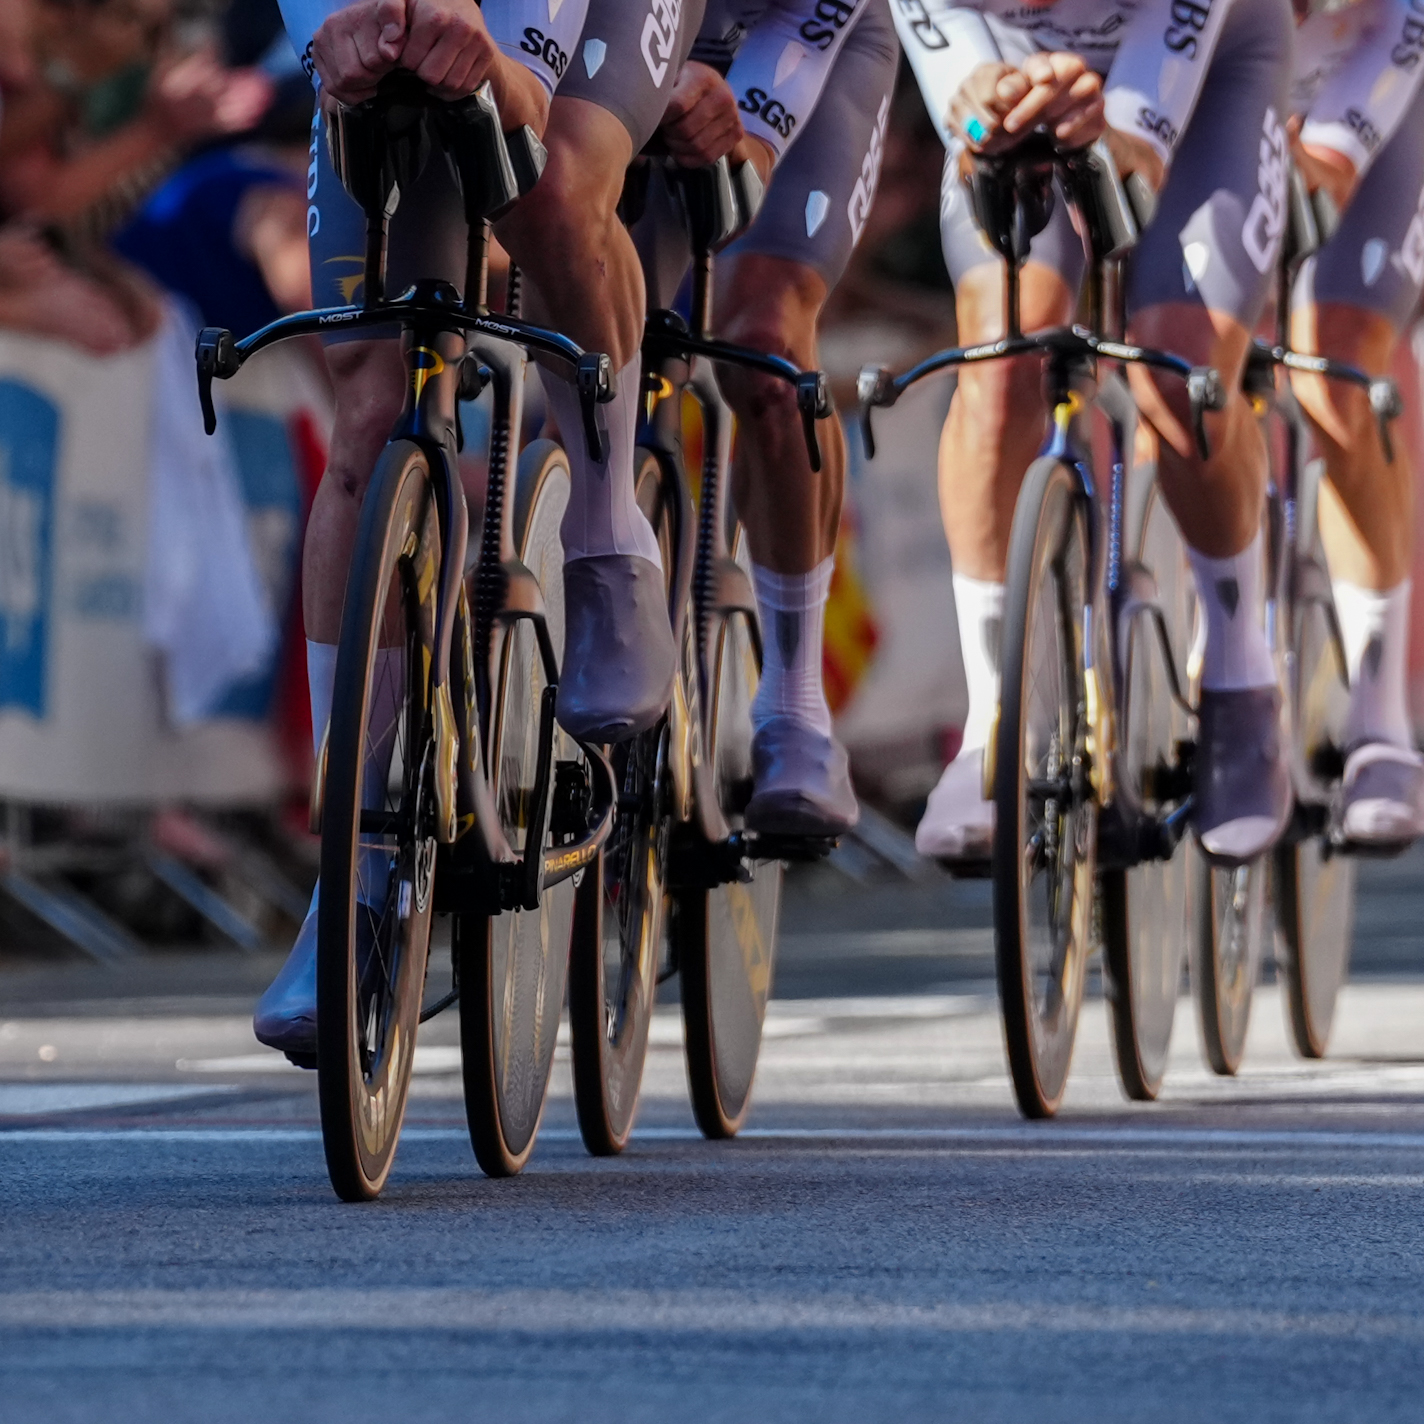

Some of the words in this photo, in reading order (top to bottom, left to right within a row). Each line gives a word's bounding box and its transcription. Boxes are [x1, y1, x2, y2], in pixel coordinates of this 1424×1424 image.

[519, 26, 569, 79] SGS
[738, 86, 796, 139] SGS
[544, 844, 596, 873] PINARELLO
